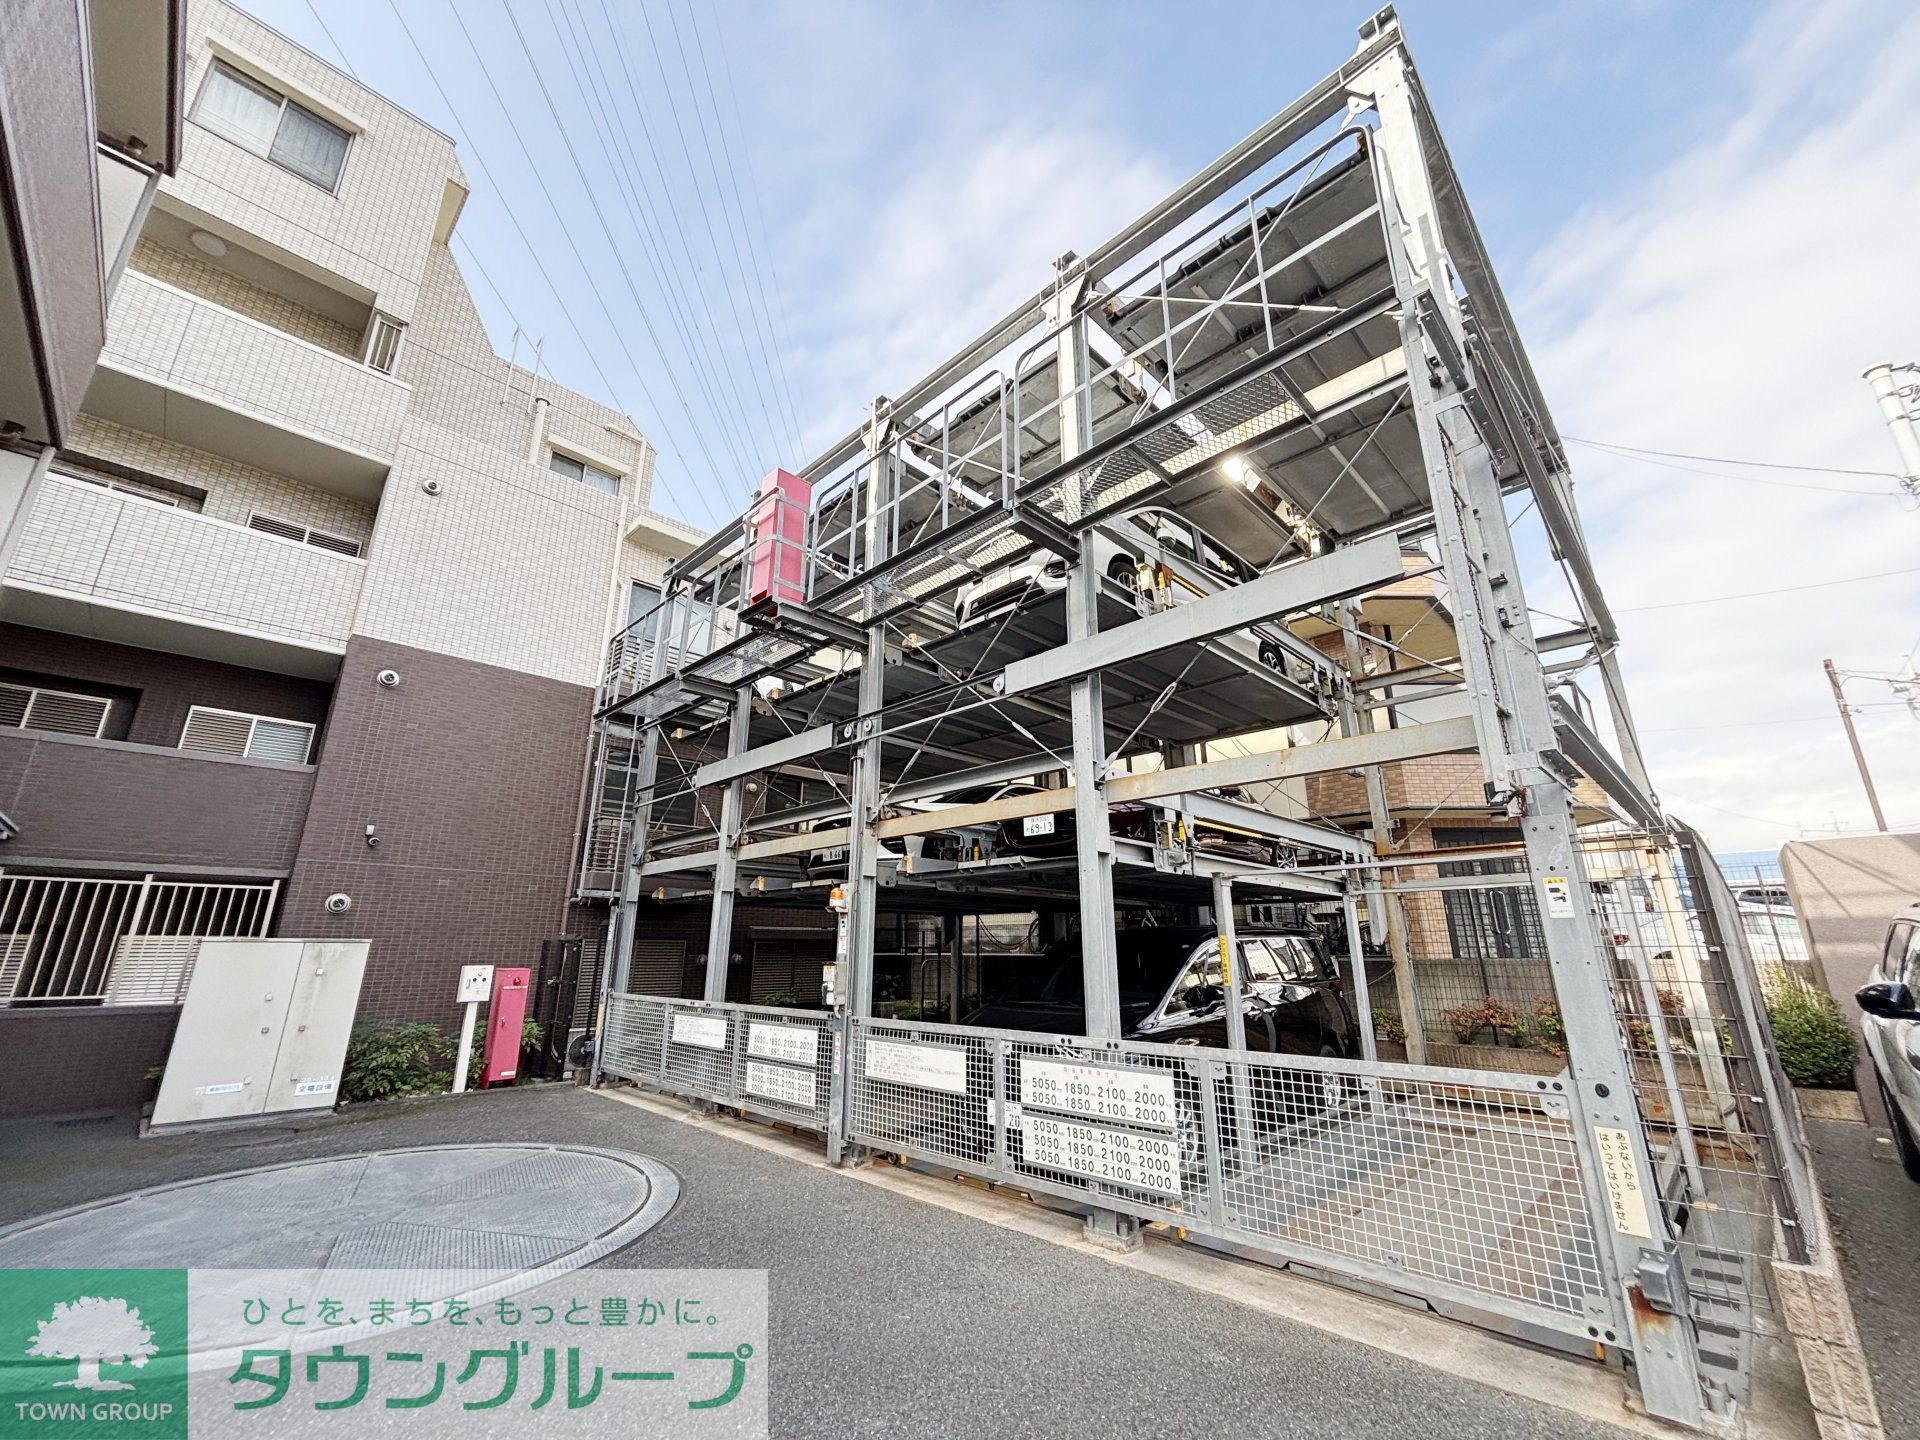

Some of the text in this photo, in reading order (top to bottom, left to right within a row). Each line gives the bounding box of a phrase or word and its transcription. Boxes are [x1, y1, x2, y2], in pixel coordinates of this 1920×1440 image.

[1032, 1077, 1056, 1091] 5050
[1065, 1082, 1090, 1096] 1850
[1098, 1086, 1126, 1100] 2100
[1134, 1091, 1164, 1106] 2000
[1032, 1092, 1166, 1122] 5050 1850 2100 2000
[1033, 1120, 1168, 1156] 5050 1850 2100 2000
[1034, 1135, 1170, 1172] 5050 1850 2100 2000
[1035, 1150, 1172, 1190] 5050 1850 2100 2000
[1616, 1132, 1636, 1191] あぶないから
[1599, 1132, 1629, 1231] はいってはいけません
